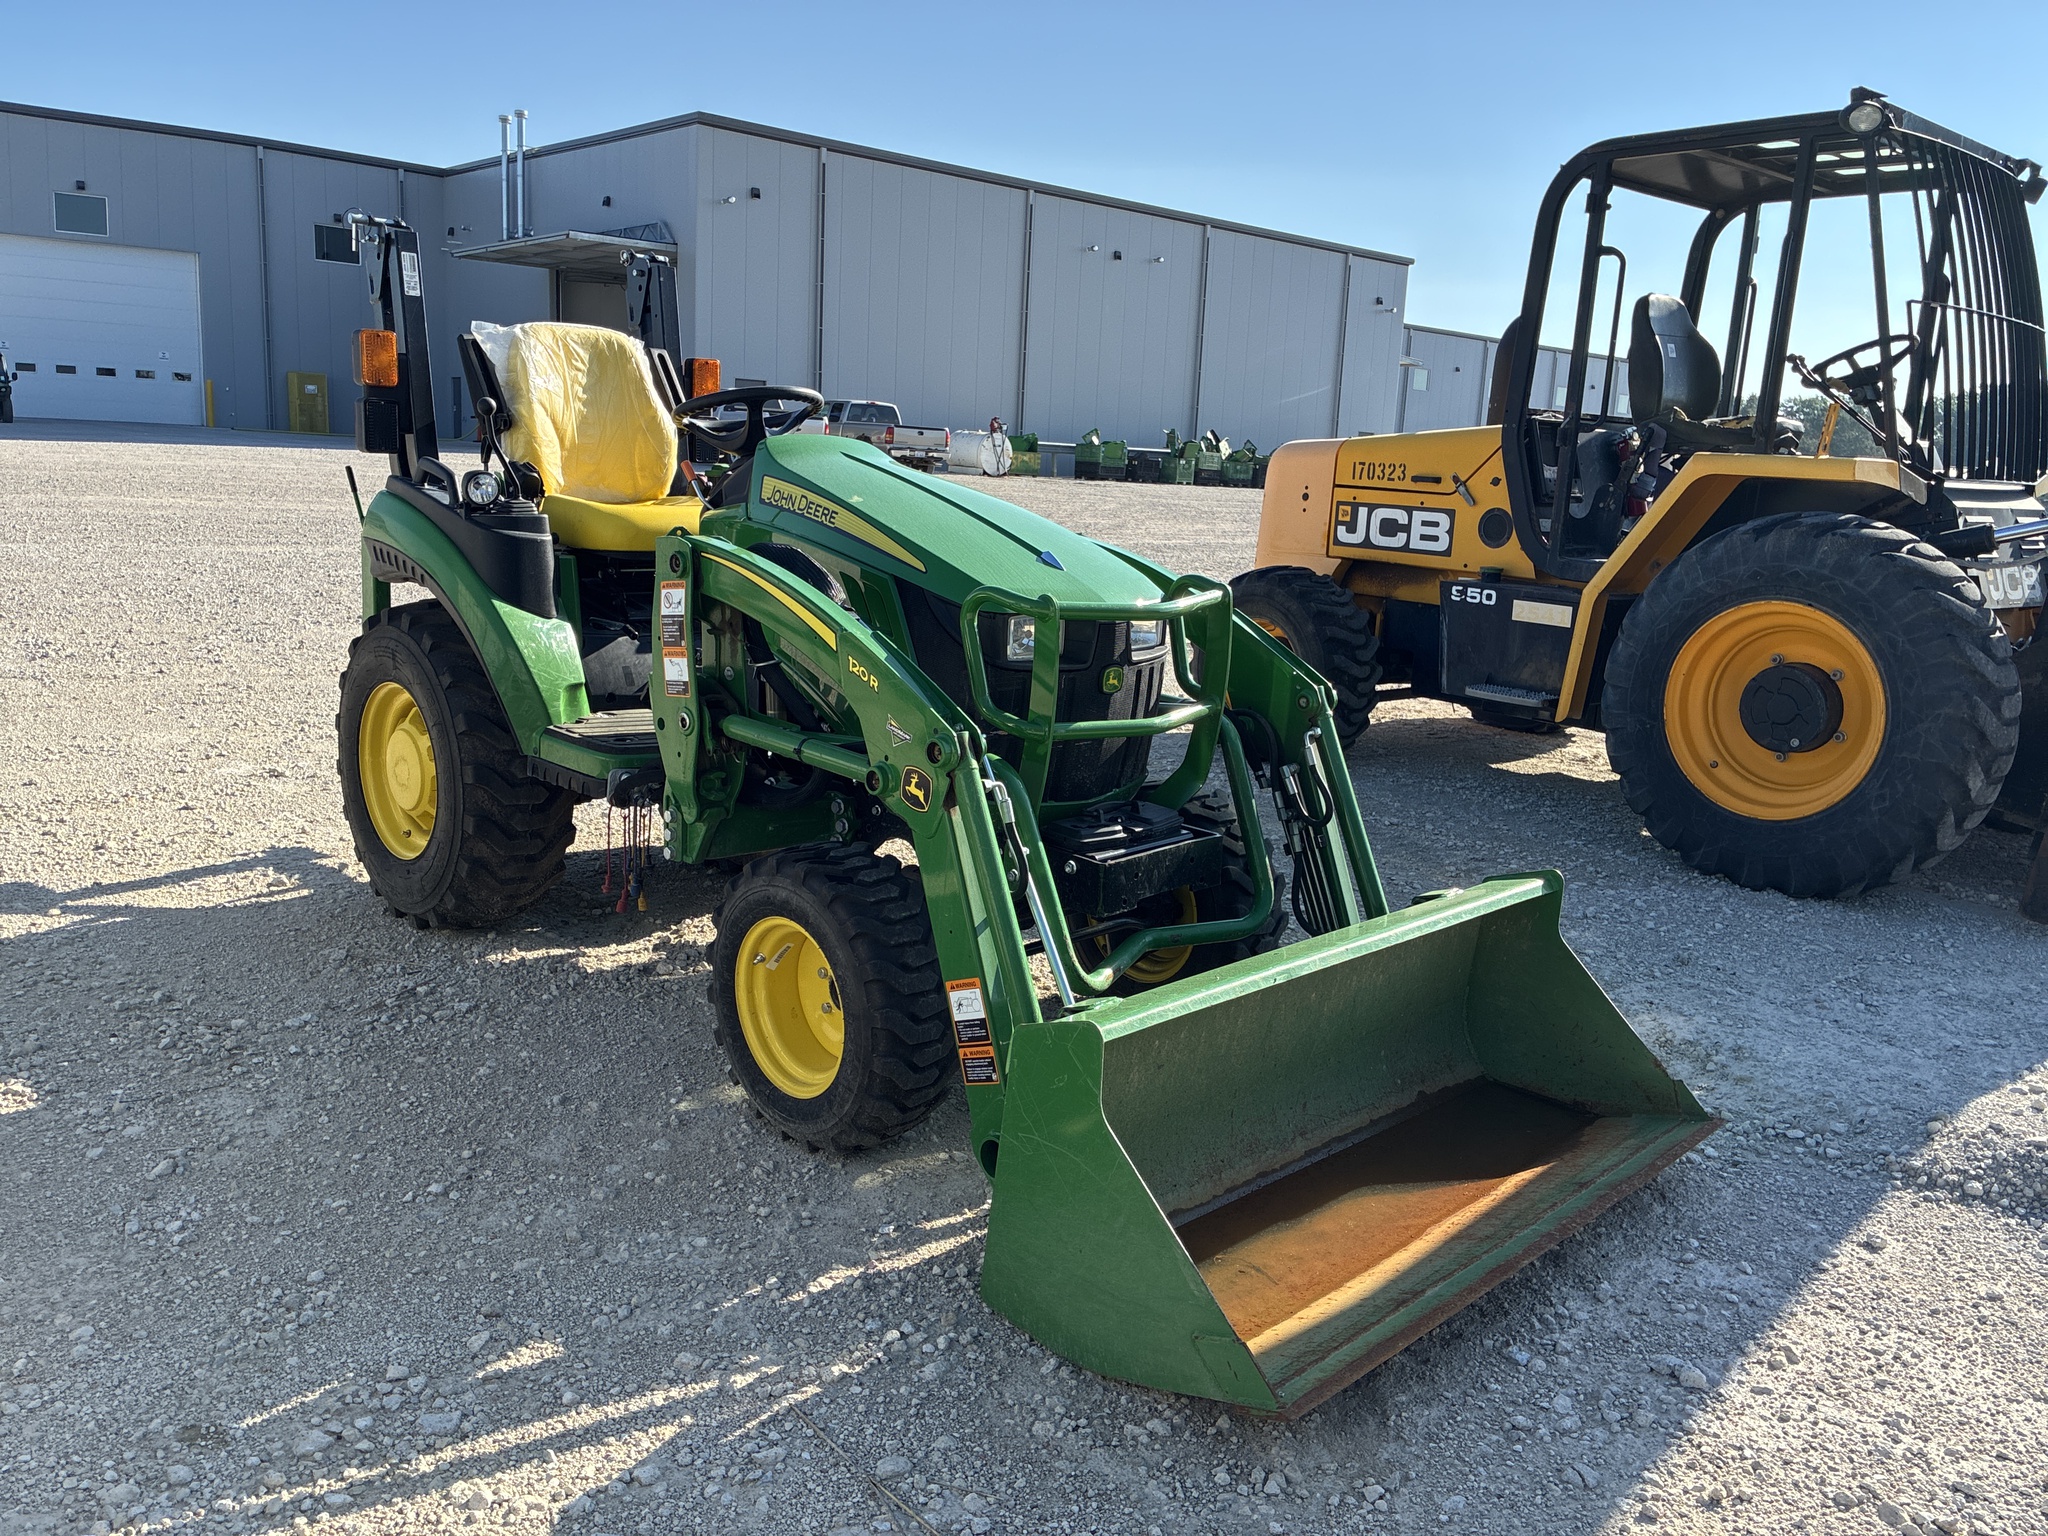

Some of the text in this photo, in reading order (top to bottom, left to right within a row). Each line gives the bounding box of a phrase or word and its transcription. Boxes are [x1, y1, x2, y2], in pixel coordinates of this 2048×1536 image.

[1352, 461, 1407, 482] 170323
[766, 484, 839, 526] JOHN DEERE
[1336, 506, 1451, 552] JCB
[1989, 565, 2043, 601] JCB
[848, 655, 879, 692] 120 R
[955, 981, 977, 989] WARNING
